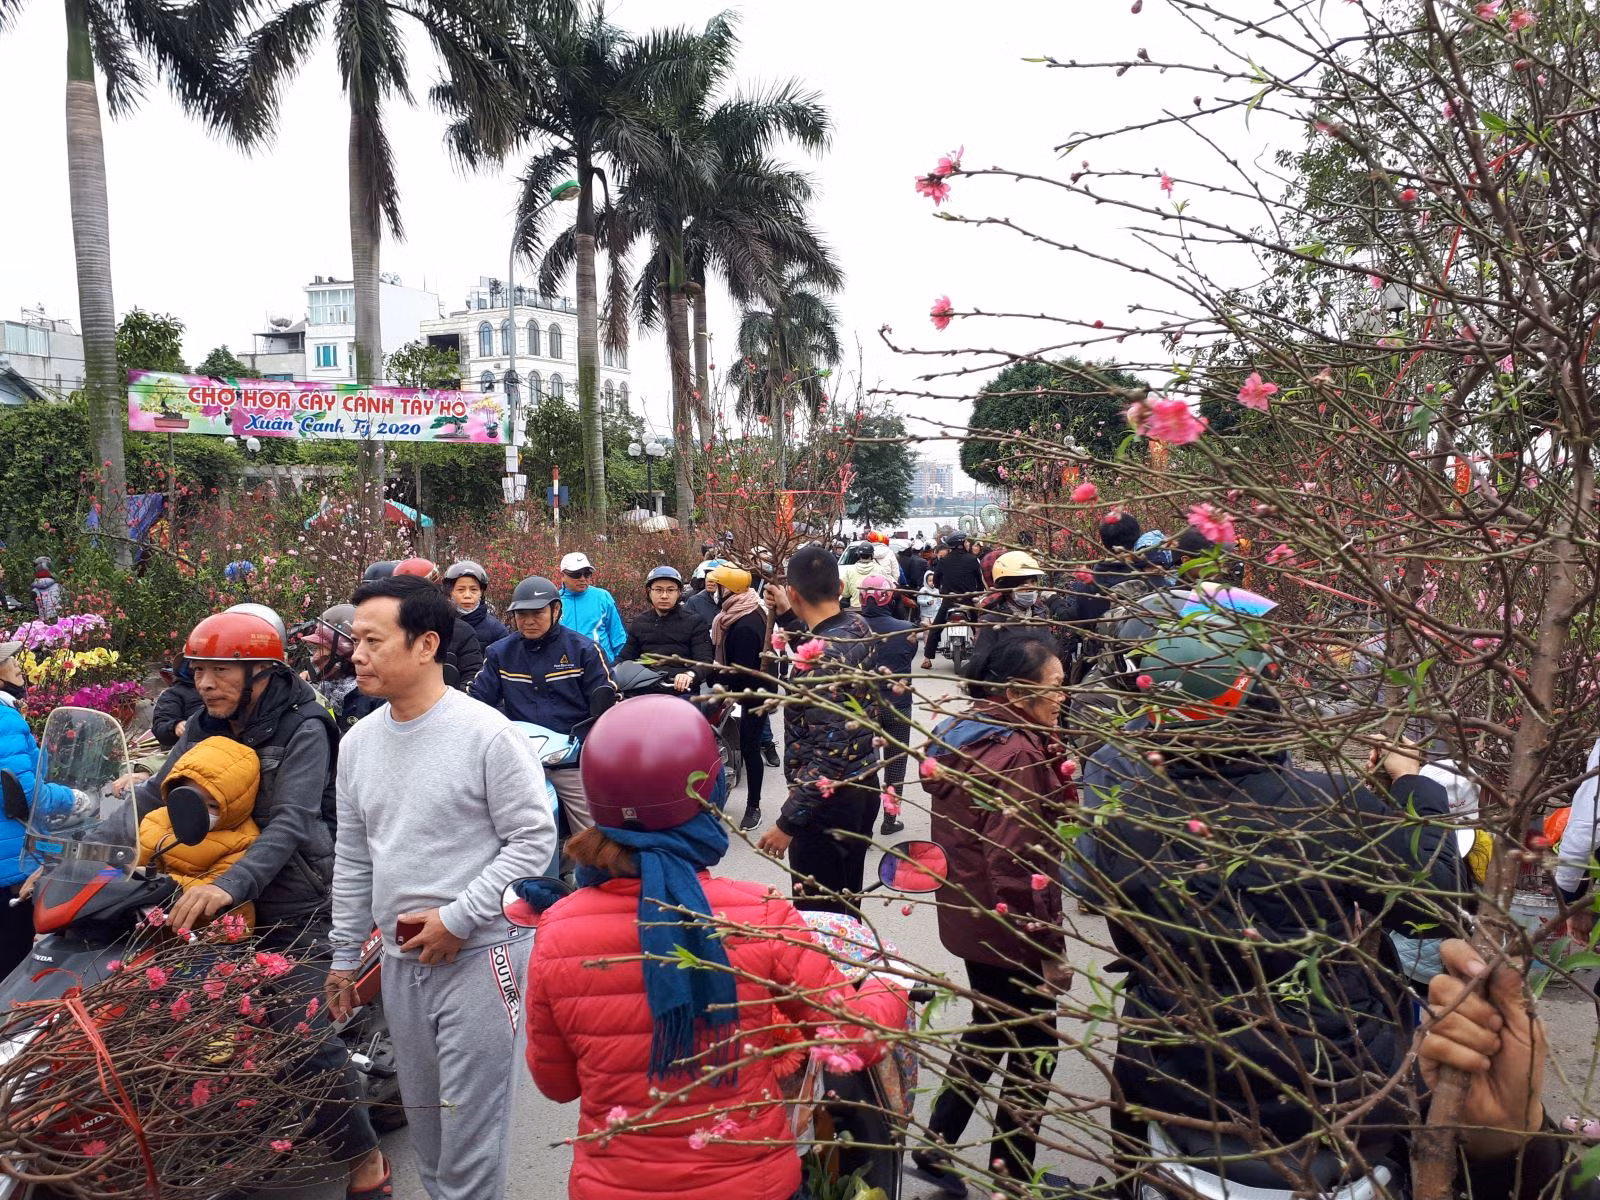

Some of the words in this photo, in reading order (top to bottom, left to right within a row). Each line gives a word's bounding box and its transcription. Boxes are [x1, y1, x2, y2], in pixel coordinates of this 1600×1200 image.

[188, 387, 236, 412] CHỢ
[243, 390, 292, 410] HOA
[298, 389, 337, 411] CÂY
[343, 391, 395, 414] CẢNH
[400, 395, 434, 416] TÂY
[440, 392, 467, 417] HỒ
[245, 415, 293, 431] Xuân
[301, 417, 345, 433] Canh
[377, 423, 421, 435] 2020
[494, 945, 518, 1009] COUTURE
